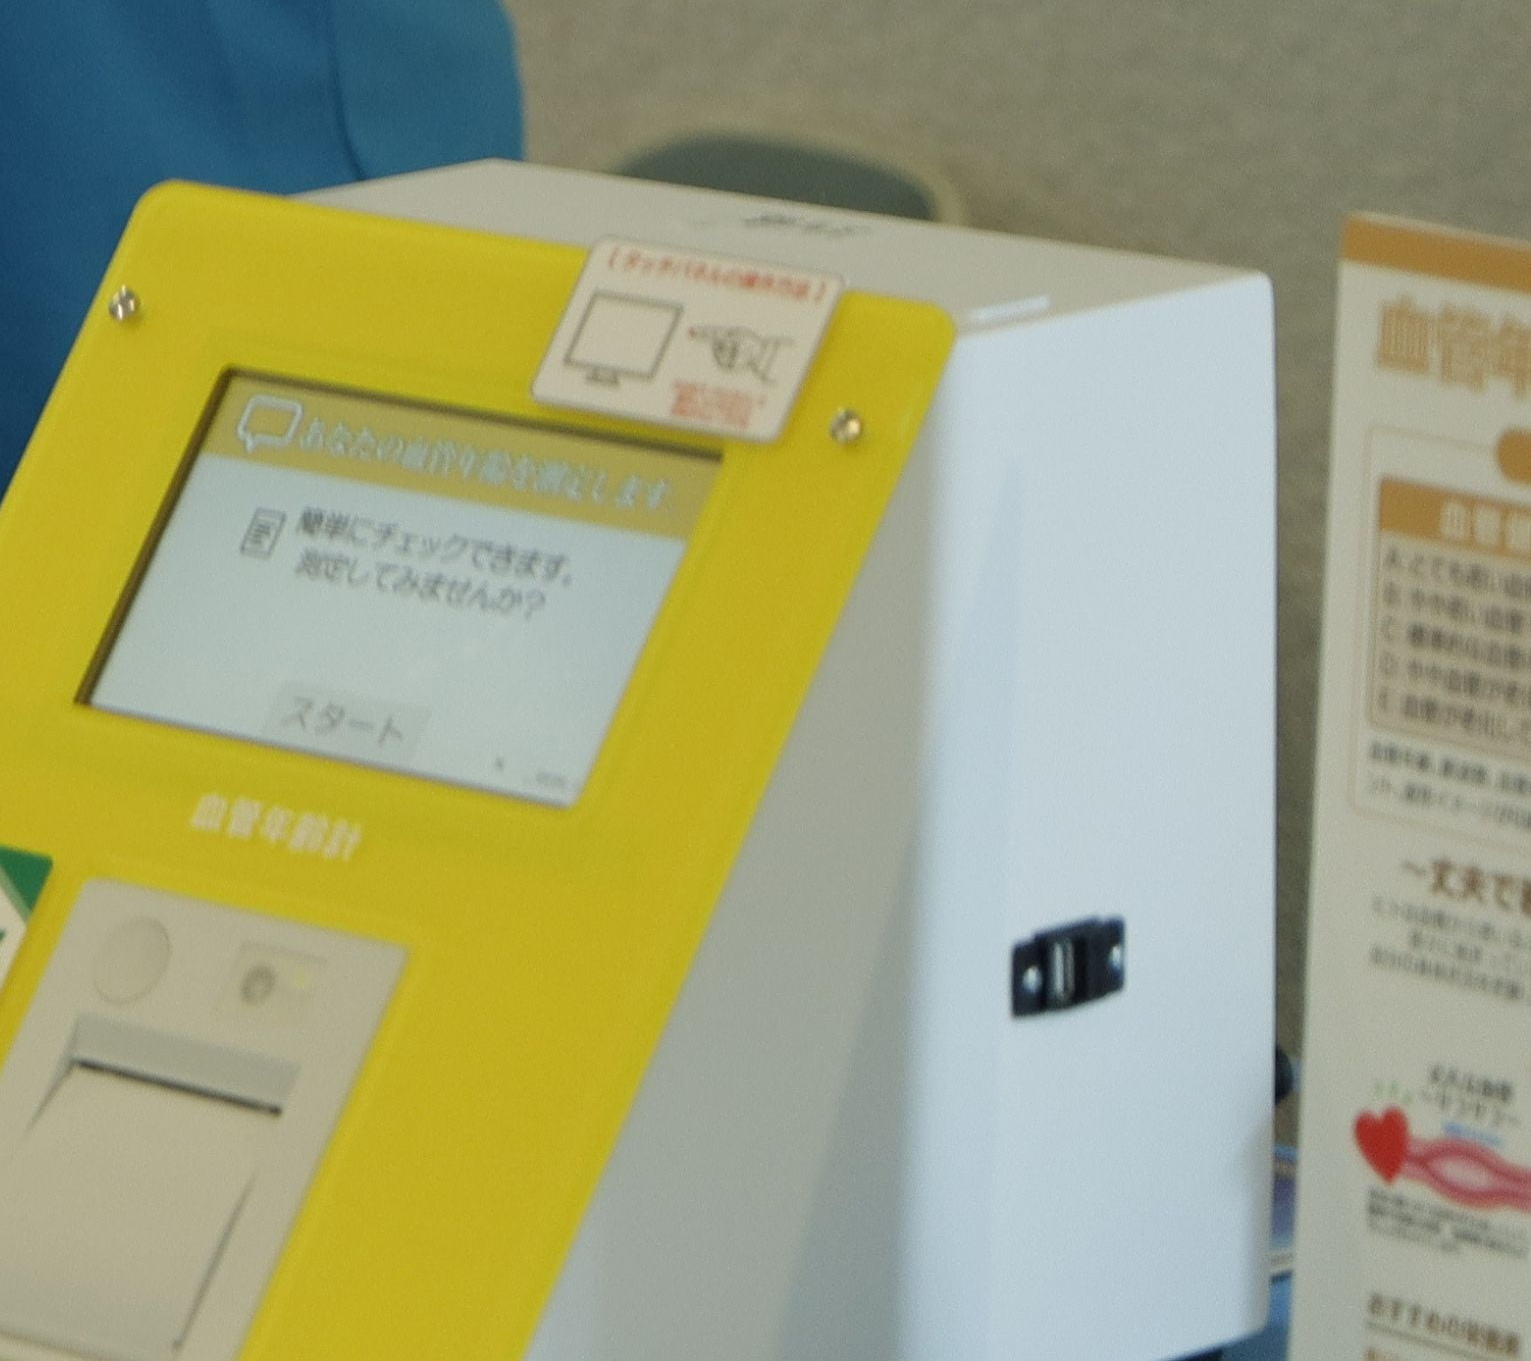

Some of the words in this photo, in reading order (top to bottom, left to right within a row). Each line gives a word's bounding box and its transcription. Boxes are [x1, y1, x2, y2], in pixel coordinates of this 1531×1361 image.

[293, 506, 575, 588] 簡単にチェックできます。
[293, 548, 547, 622] 測定してみませんか?
[282, 693, 405, 750] スタート
[189, 790, 364, 863] 血管年齢計
